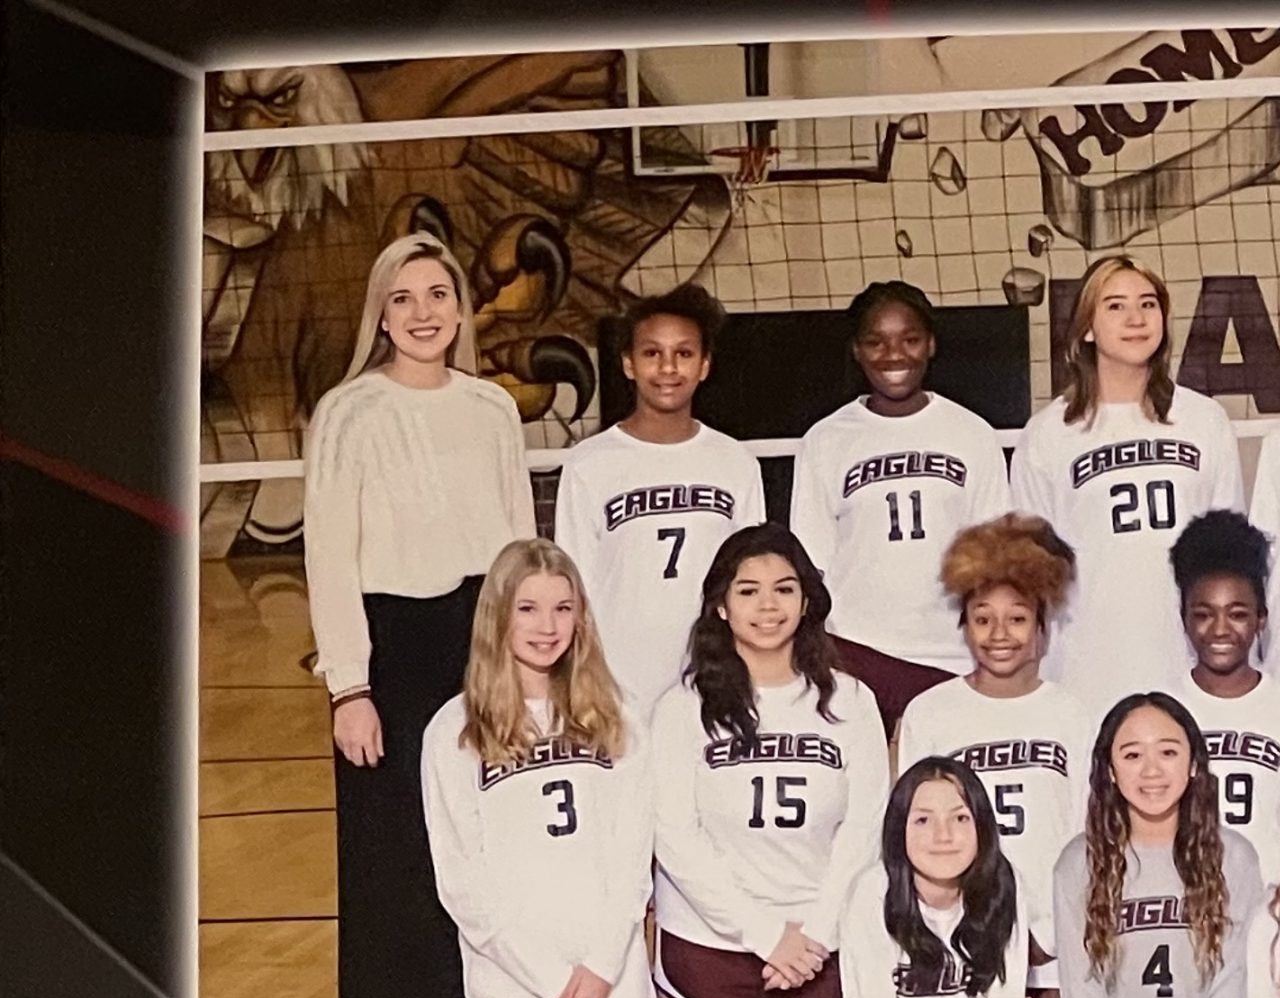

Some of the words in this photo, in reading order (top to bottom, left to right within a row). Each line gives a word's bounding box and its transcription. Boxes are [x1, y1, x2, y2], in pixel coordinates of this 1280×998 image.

[843, 450, 967, 498] EAGLES
[1071, 438, 1201, 489] EAGLES
[603, 484, 735, 532] EAGLES
[885, 490, 926, 541] 11
[1110, 480, 1176, 533] 20
[657, 527, 686, 579] 7
[704, 733, 842, 769] EAGLES
[542, 779, 577, 837] 3
[748, 776, 807, 829] 15
[995, 783, 1025, 836] 5
[1141, 944, 1174, 998] 4
